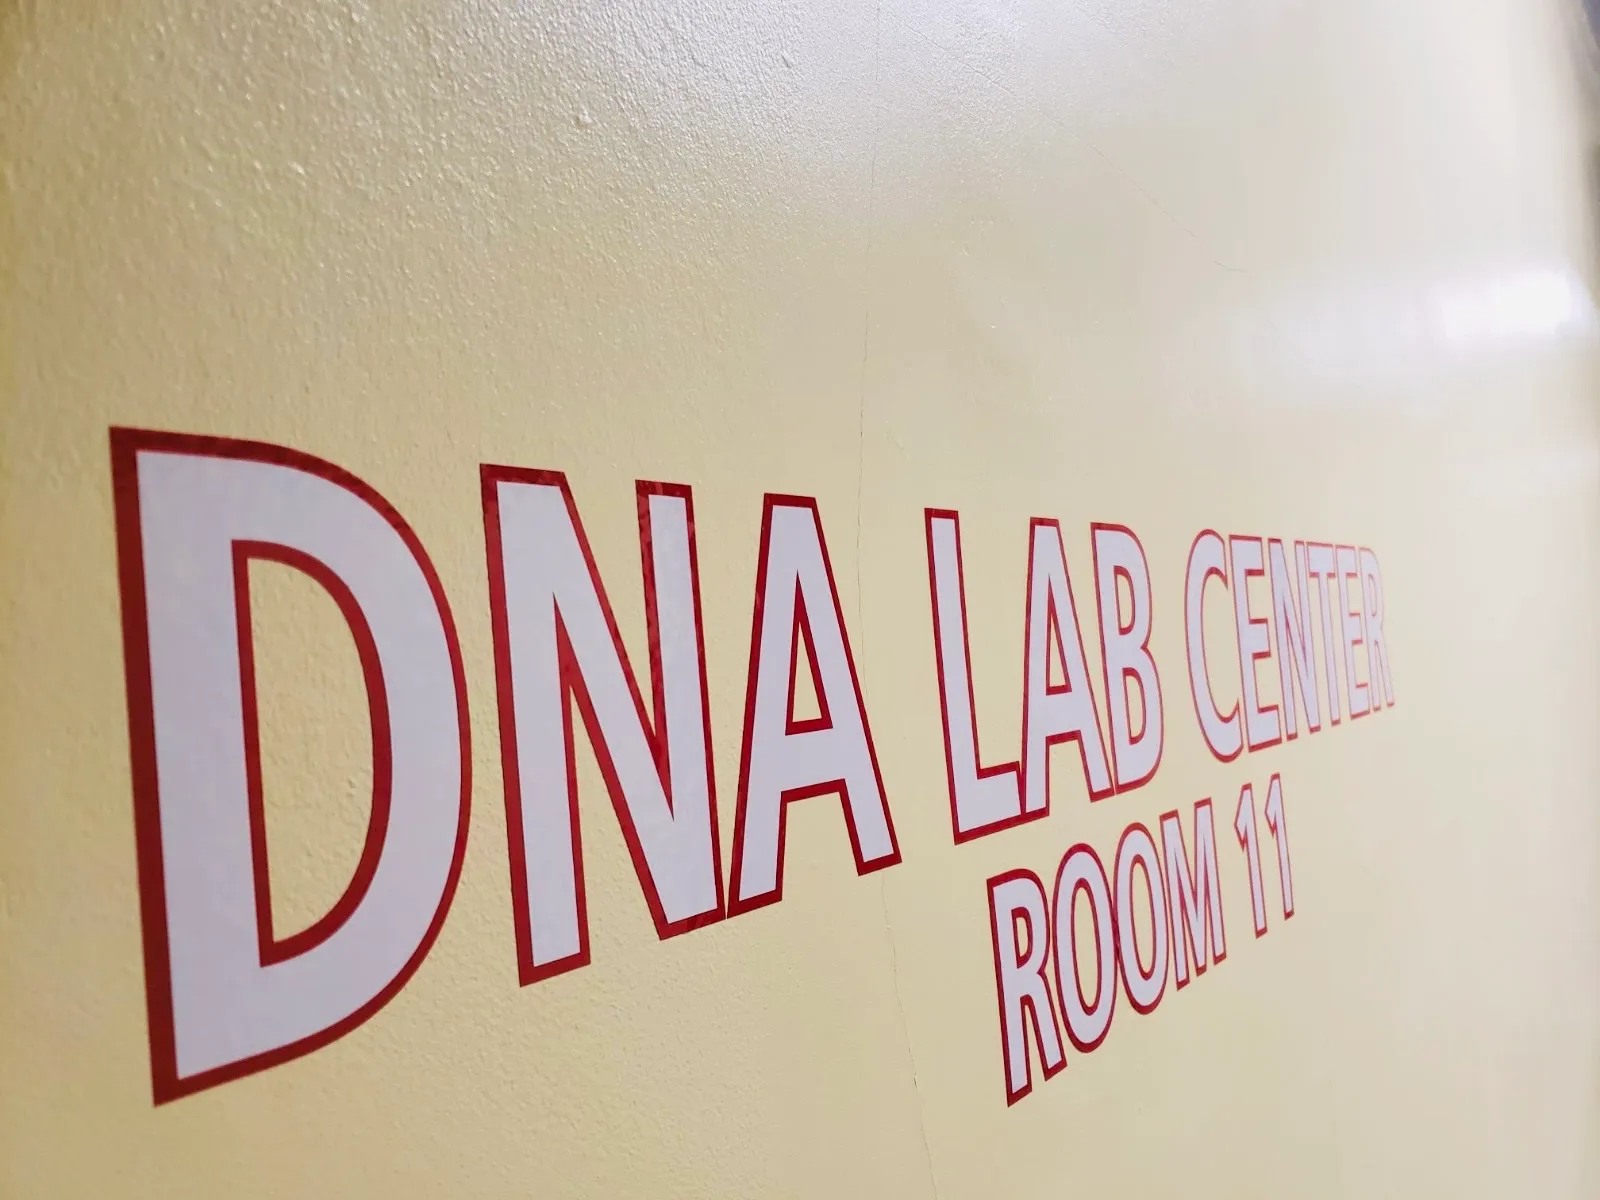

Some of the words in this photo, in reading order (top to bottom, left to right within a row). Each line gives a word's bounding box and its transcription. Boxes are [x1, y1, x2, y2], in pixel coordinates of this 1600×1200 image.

[108, 425, 903, 1107] DNA
[923, 507, 1164, 846] LAB
[1184, 528, 1395, 763] CENTER
[986, 797, 1227, 1107] ROOM
[1234, 773, 1295, 938] 11
